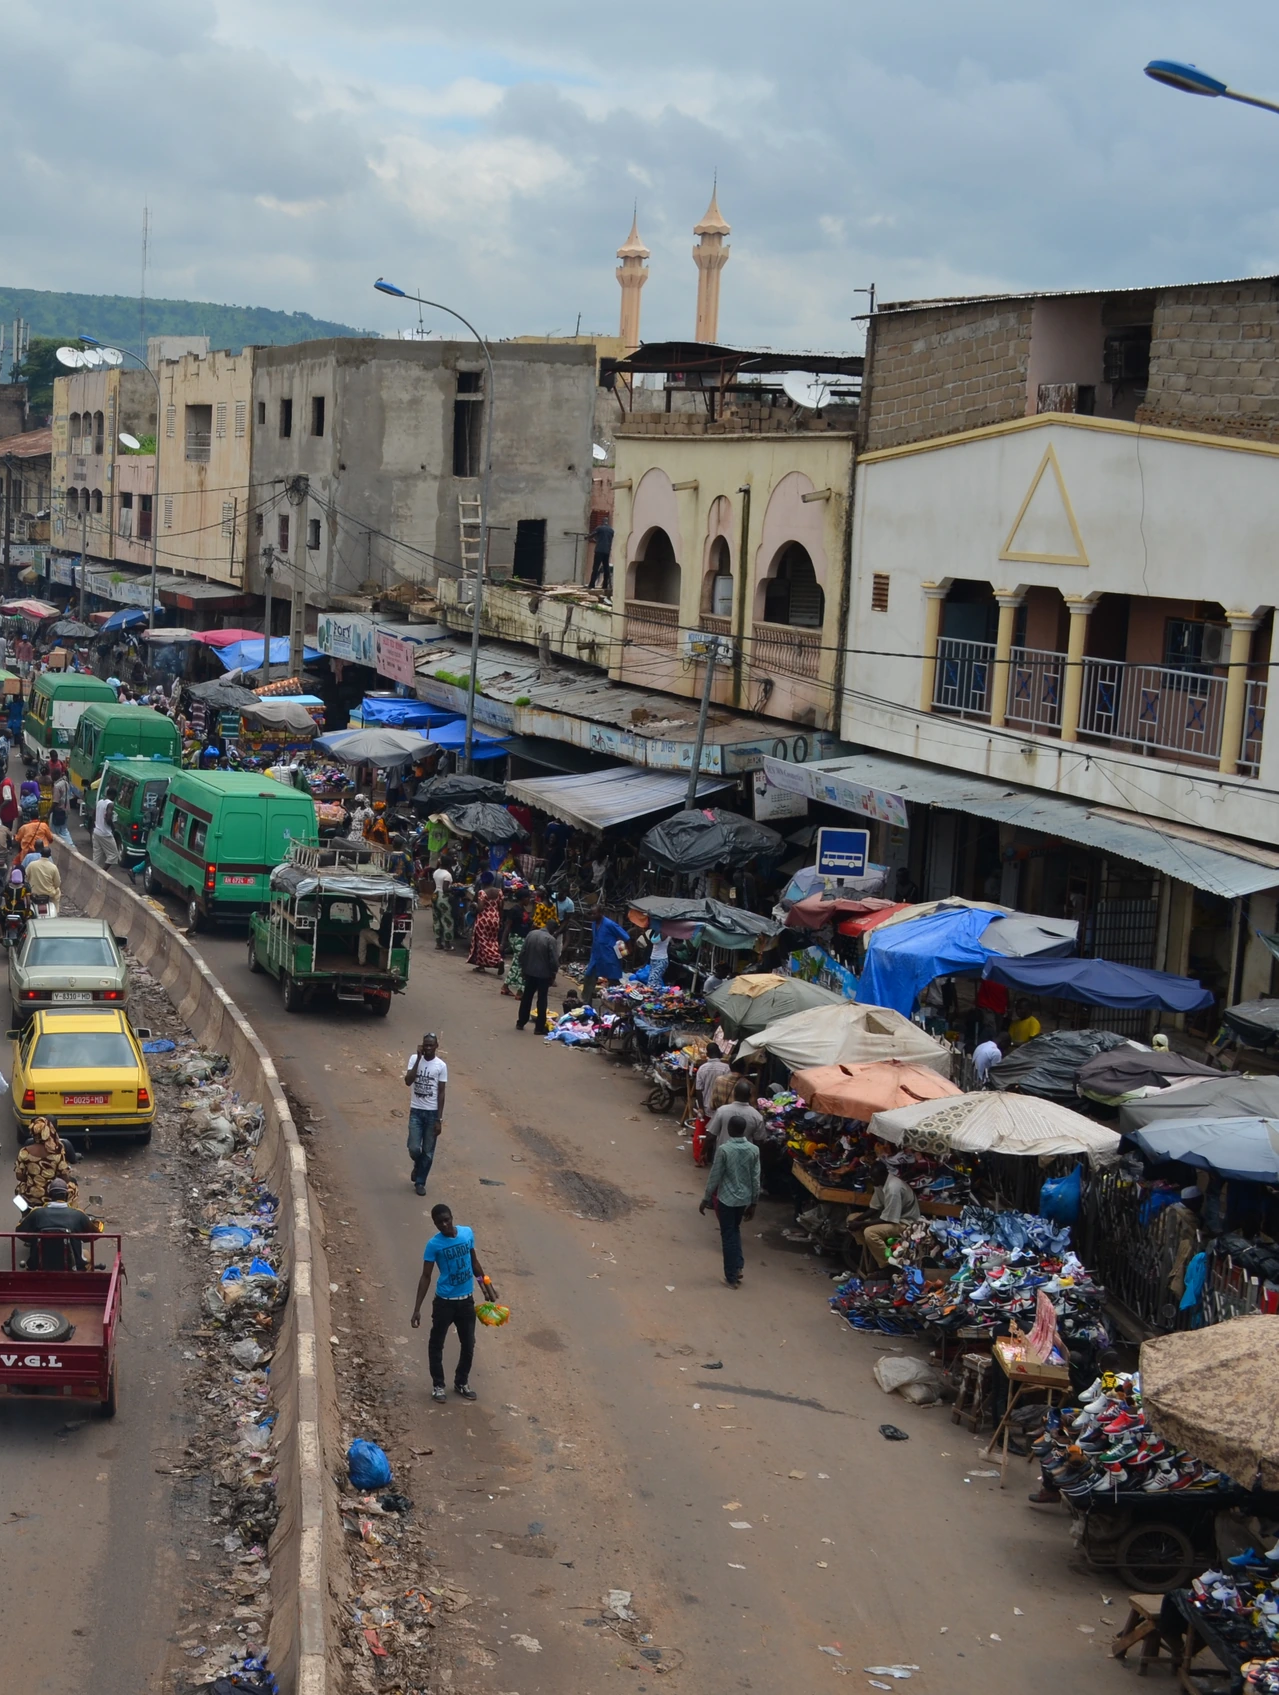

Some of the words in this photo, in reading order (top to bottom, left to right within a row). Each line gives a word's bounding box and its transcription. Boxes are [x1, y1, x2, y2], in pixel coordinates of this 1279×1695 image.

[446, 1244, 470, 1260] GARDE
[456, 1258, 466, 1269] LA
[0, 1354, 62, 1367] V.G.L
